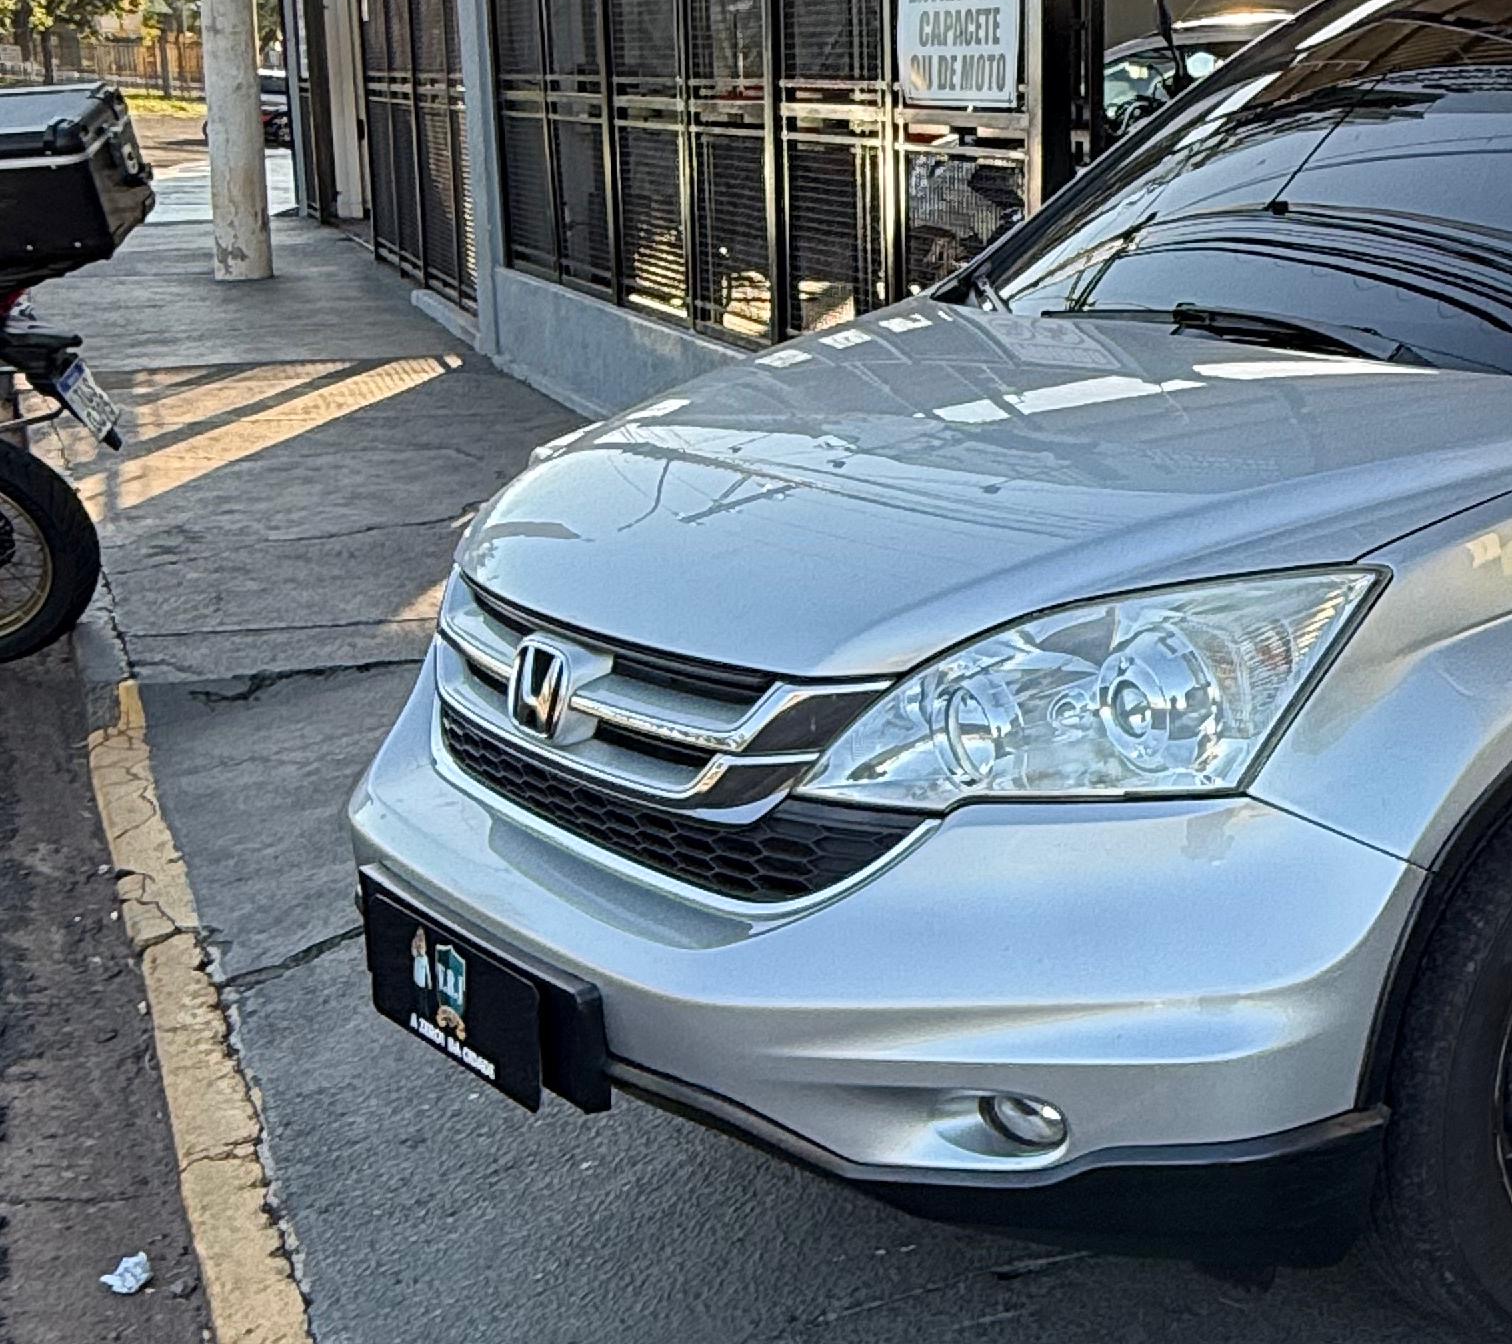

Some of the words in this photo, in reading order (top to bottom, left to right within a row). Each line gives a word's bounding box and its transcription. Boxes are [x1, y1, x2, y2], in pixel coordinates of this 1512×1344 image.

[918, 7, 1001, 47] CAPACETE
[910, 54, 933, 92] OU
[936, 54, 958, 92] DE
[959, 53, 1006, 93] MOTO
